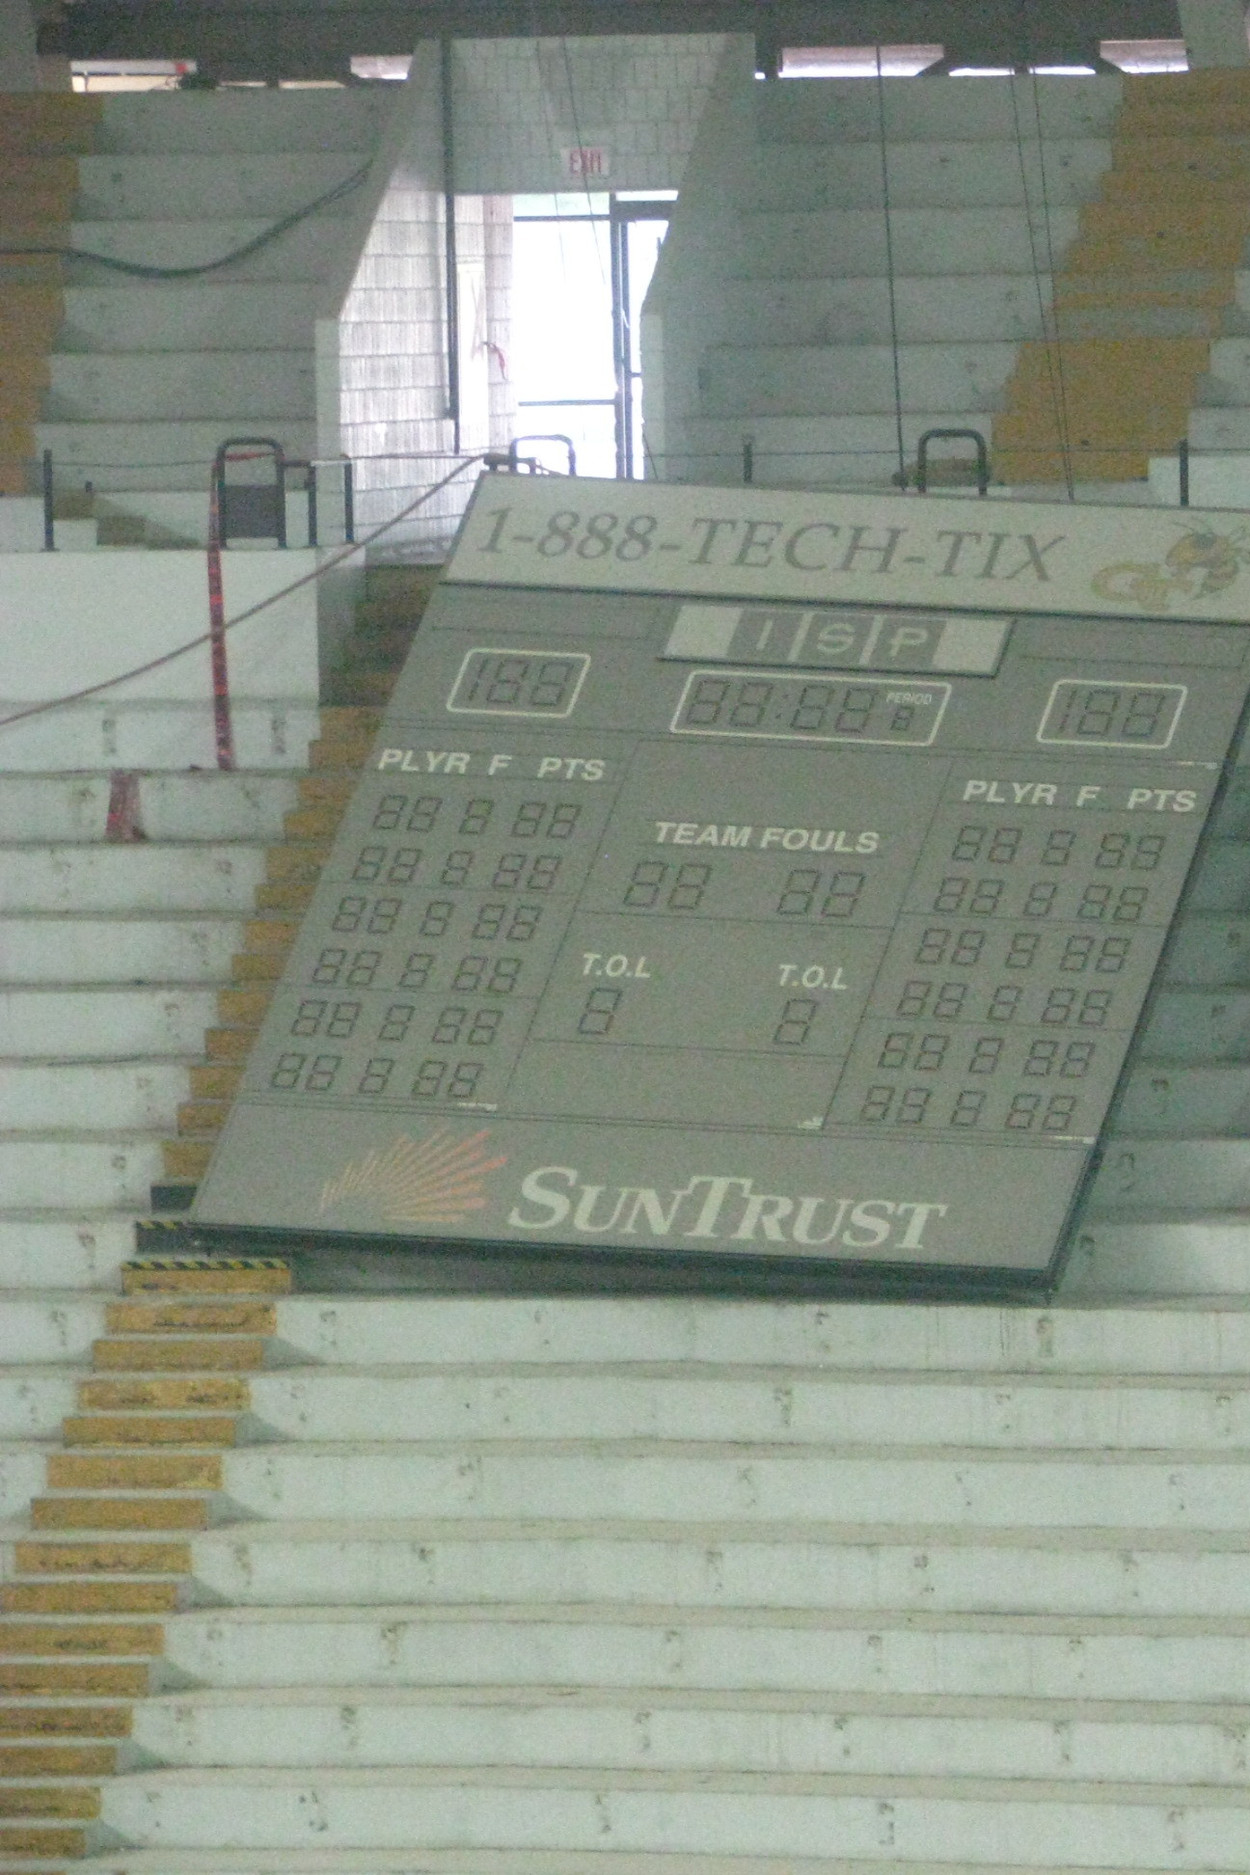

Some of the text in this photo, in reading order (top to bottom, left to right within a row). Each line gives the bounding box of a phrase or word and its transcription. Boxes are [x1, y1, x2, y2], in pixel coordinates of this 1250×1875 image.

[477, 506, 1066, 582] 1-888-TECH-TIX
[378, 749, 607, 781] PLYR F PTS
[963, 779, 1198, 813] PLYR F PTS
[654, 821, 880, 854] TEAM FOULS
